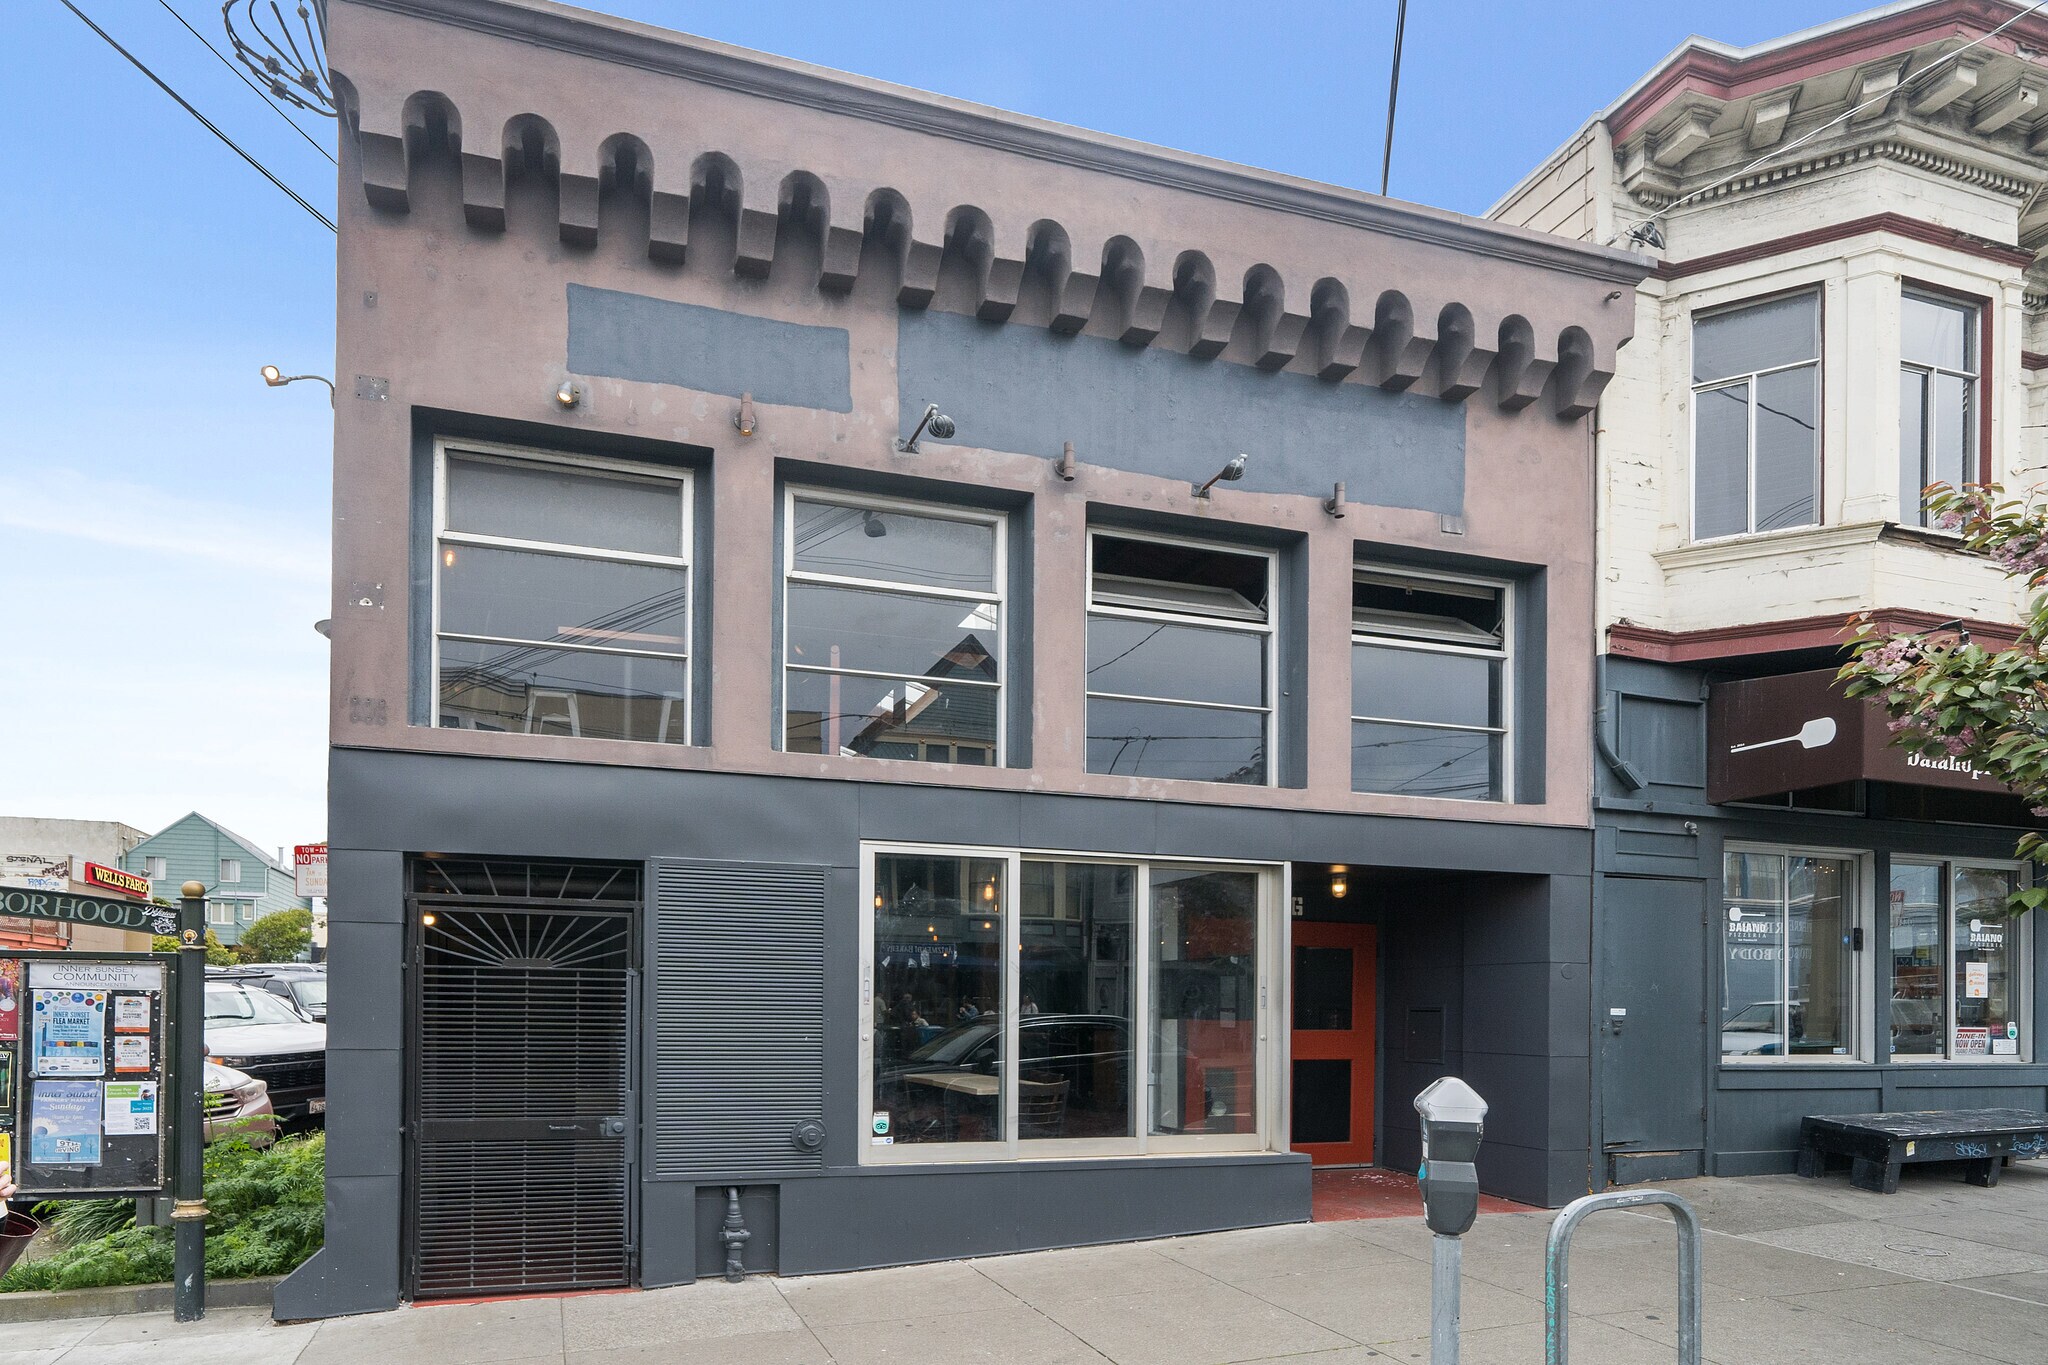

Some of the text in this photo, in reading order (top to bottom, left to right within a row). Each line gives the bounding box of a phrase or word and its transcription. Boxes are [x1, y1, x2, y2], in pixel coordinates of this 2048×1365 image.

[296, 853, 310, 865] NO
[94, 866, 125, 888] WELLS
[125, 874, 151, 895] FARGO
[1970, 933, 2003, 943] BAIANO
[58, 965, 135, 974] INNER SUNSET
[52, 972, 139, 982] COMMUNITY
[1955, 1039, 1969, 1048] NOW
[1970, 1039, 1986, 1048] OPEN
[49, 1103, 86, 1111] Sundays
